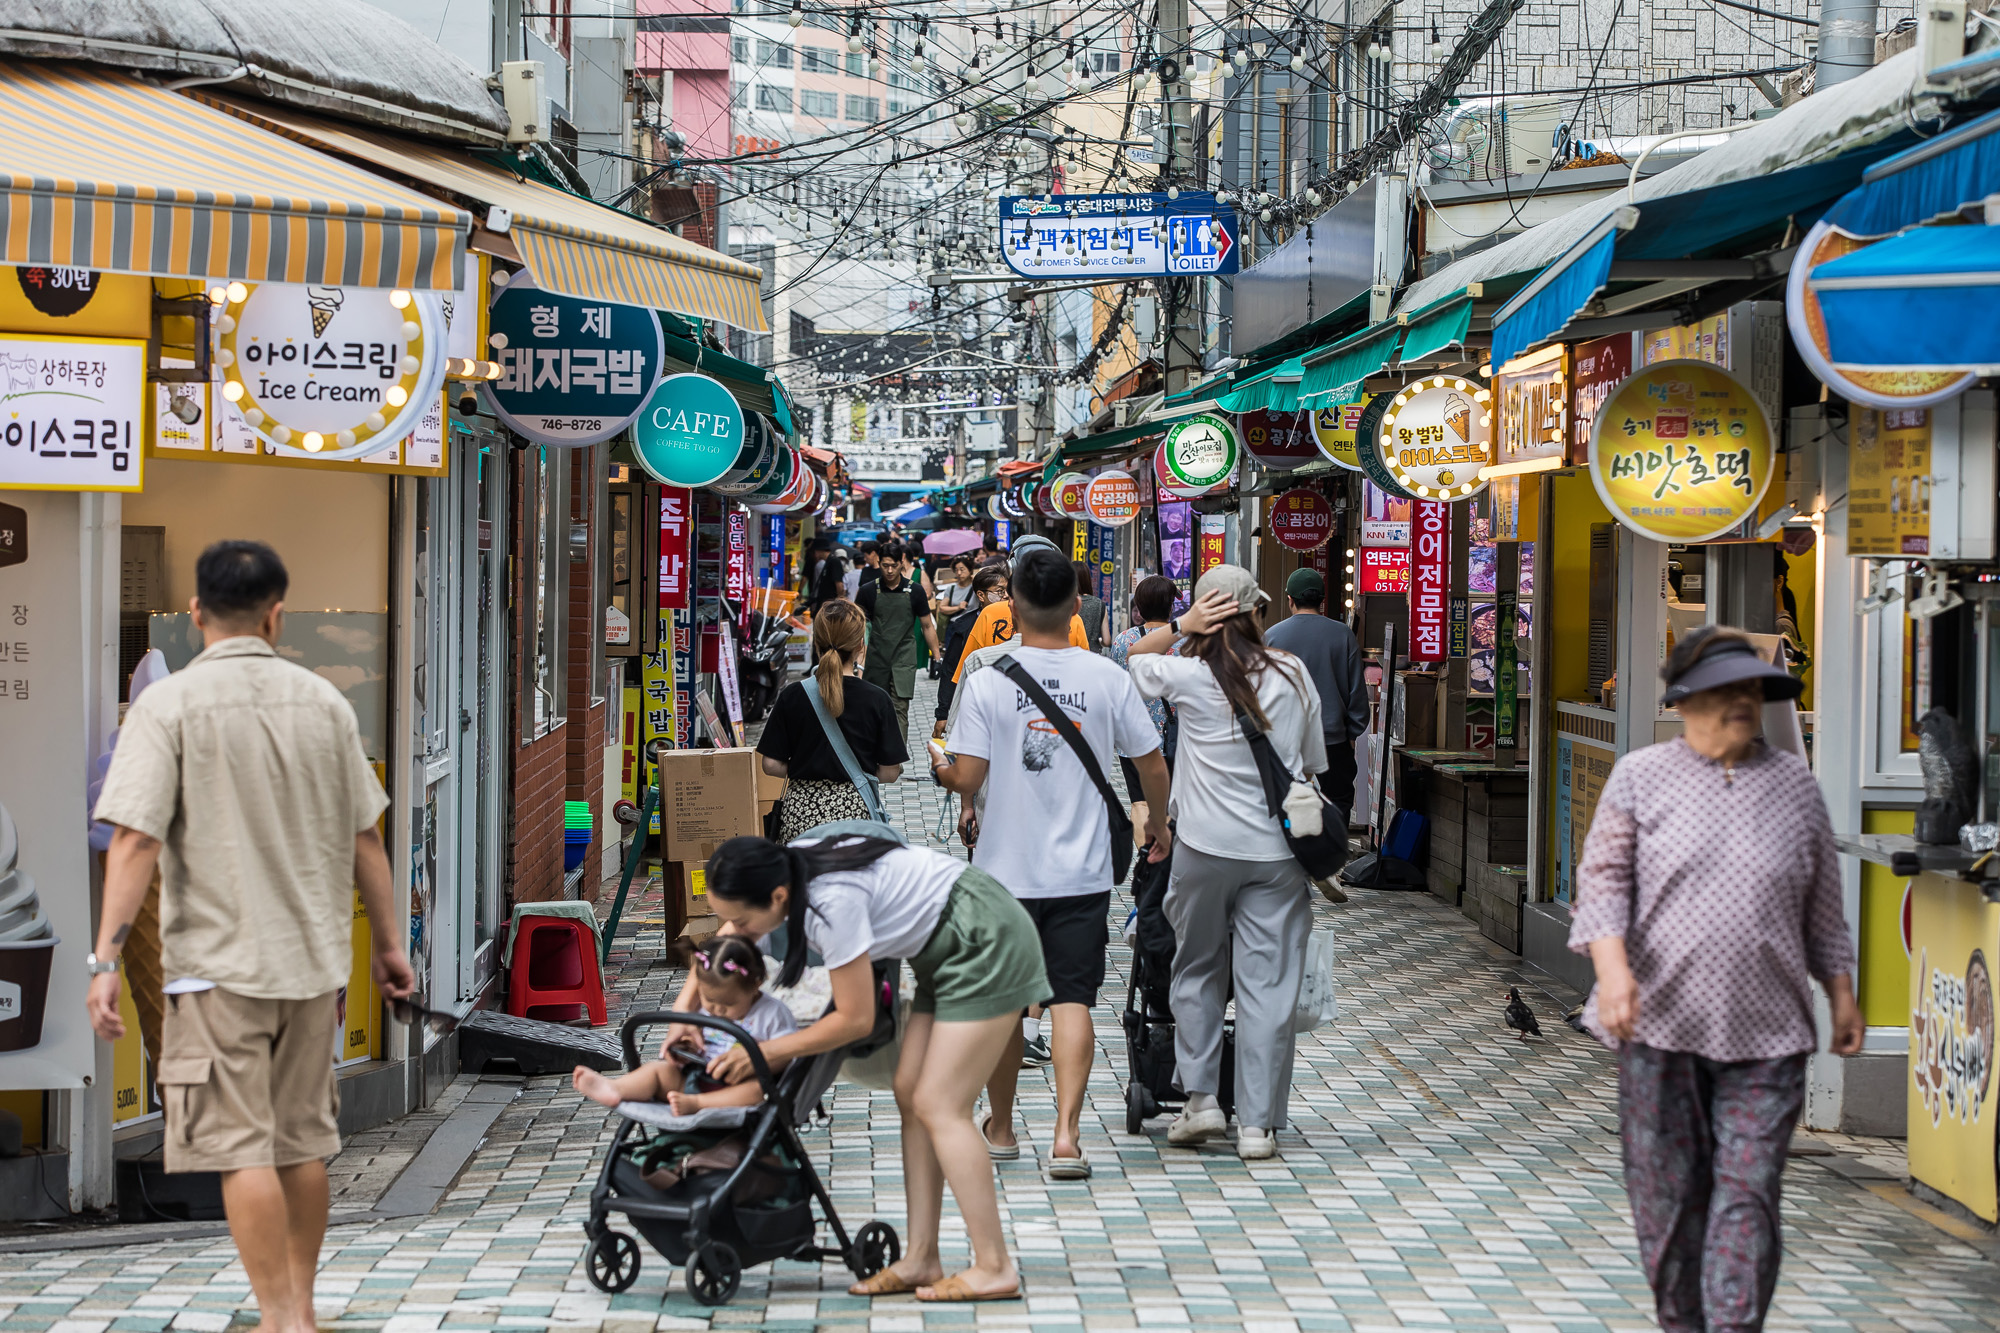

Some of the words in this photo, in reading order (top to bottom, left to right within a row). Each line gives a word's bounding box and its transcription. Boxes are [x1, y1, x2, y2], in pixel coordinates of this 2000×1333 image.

[1023, 258, 1071, 267] CUTOMER
[1073, 257, 1109, 266] SRVICE
[1111, 256, 1146, 265] CENER
[1172, 257, 1216, 270] TOILET
[246, 341, 397, 379] 아이스크림
[40, 359, 107, 388] 상하목장
[496, 348, 646, 395] 돼지국밥
[258, 379, 296, 399] Ice
[304, 380, 381, 403] Cream
[541, 418, 602, 431] 746-8726
[652, 406, 731, 439] CAFE
[1622, 416, 1652, 437] 승기
[1657, 419, 1687, 435] 元祖
[1691, 417, 1722, 437] 찹쌀
[0, 418, 130, 472] 이스크림
[1399, 427, 1414, 445] 왕
[1416, 425, 1444, 445] 벌집
[656, 438, 691, 451] COFFEE
[693, 443, 705, 452] TO
[707, 445, 720, 454] GO
[1333, 440, 1357, 452] 연탄
[1399, 443, 1488, 468] 아이스크림
[1610, 443, 1753, 500] 씨앗호떡
[1091, 491, 1140, 506] 산곰장어
[1366, 531, 1385, 539] KNN
[1377, 569, 1399, 580] 황금
[1375, 582, 1396, 592] 051.
[1452, 599, 1467, 621] 쌀
[1452, 623, 1467, 656] 잡곡
[1497, 738, 1515, 746] TERRA
